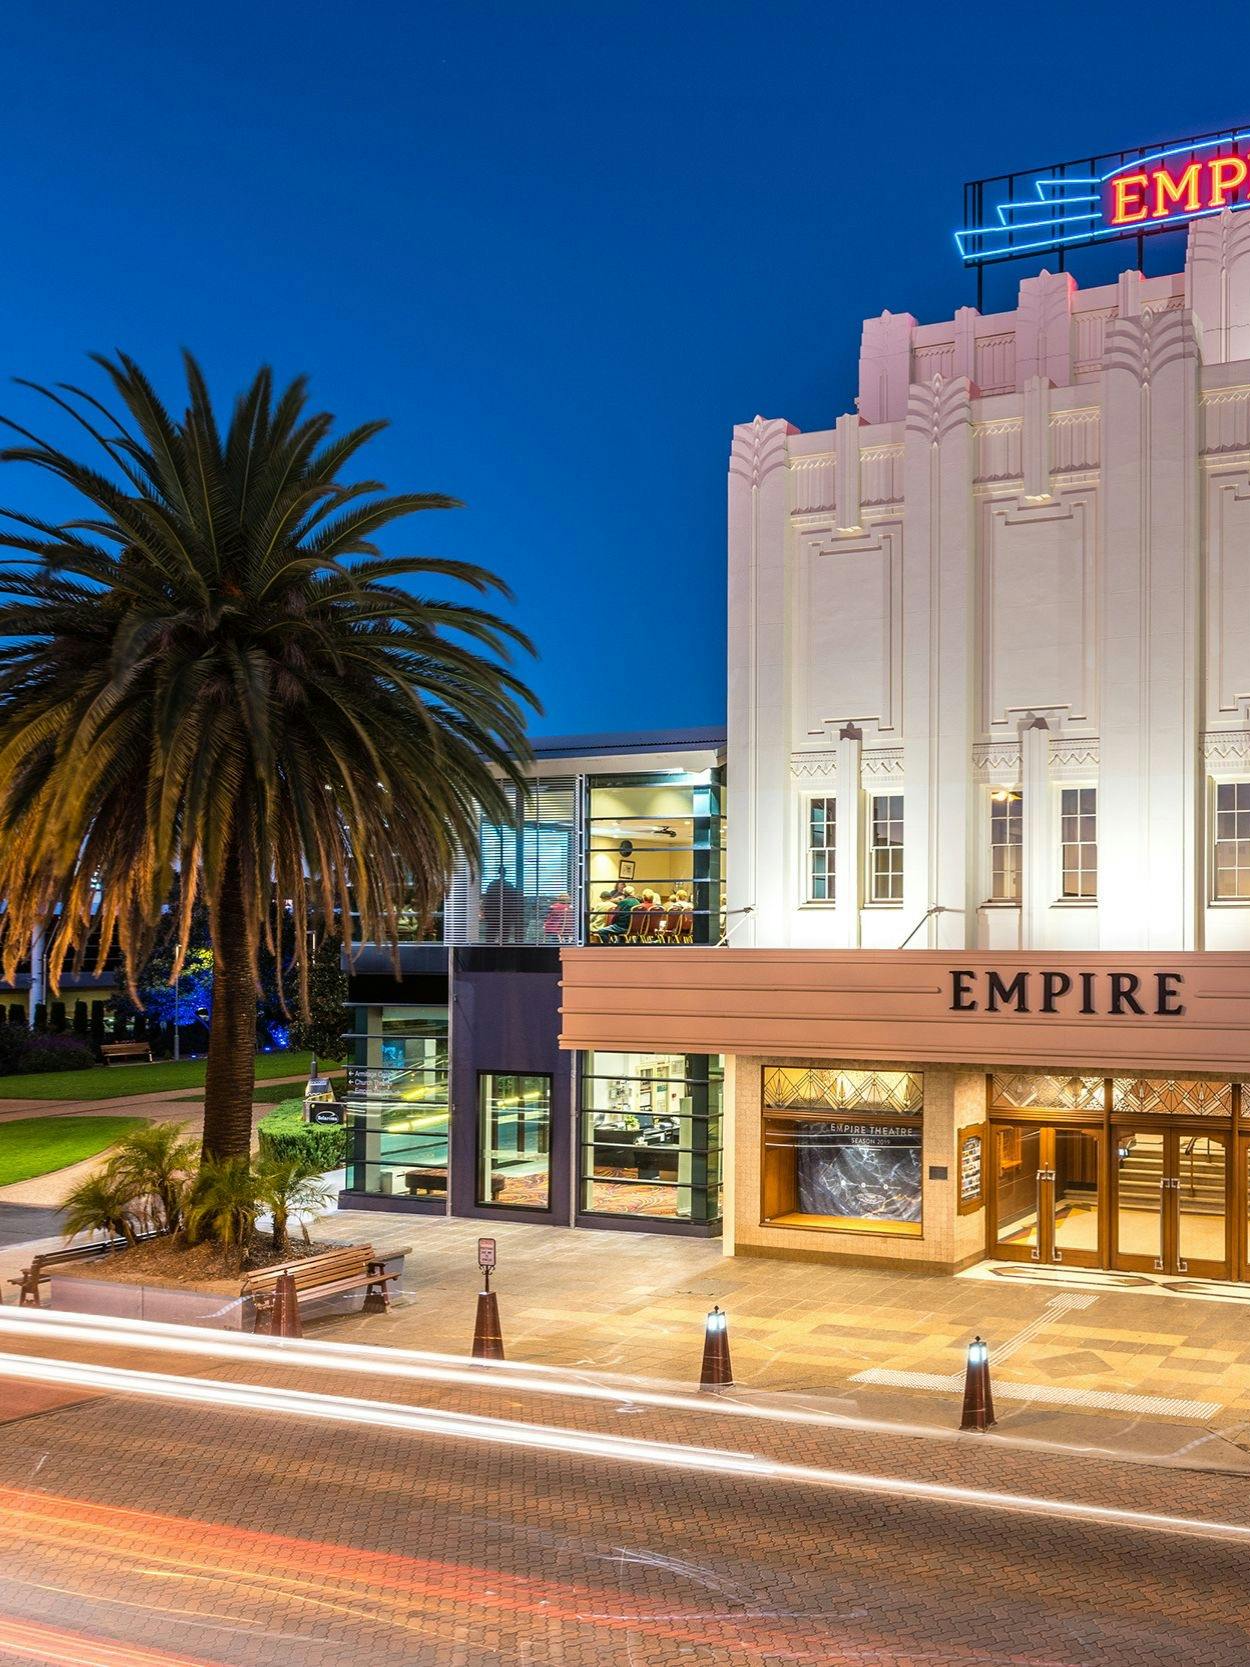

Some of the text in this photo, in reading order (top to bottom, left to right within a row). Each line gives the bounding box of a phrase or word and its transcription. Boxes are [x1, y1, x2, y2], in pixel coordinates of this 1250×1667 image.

[948, 970, 1185, 1015] EMPIRE
[830, 1123, 913, 1137] EMPIRE THEATRE
[851, 1137, 875, 1145] SEASON
